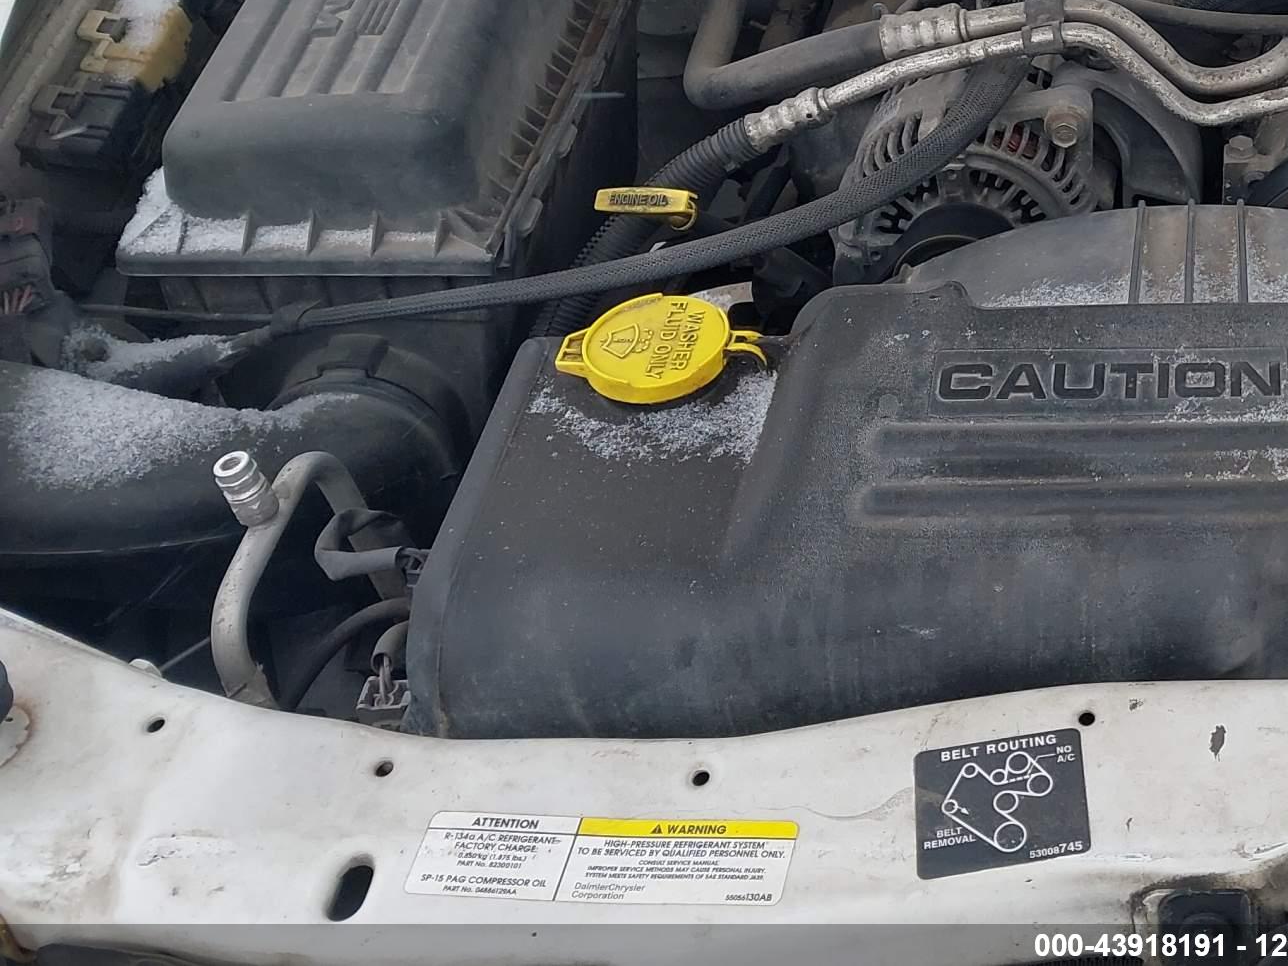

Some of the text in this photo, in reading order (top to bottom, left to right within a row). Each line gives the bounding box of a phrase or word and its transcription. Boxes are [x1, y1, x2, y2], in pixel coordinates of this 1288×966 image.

[608, 194, 668, 206] ENGINE OIL
[646, 301, 688, 379] FLUID ONLY
[669, 310, 706, 371] WASHER
[937, 361, 1282, 400] CAUTION
[941, 734, 1057, 762] BELT ROUTING
[1056, 746, 1072, 754] NO
[1057, 754, 1076, 763] A/C
[472, 817, 539, 829] ATTENTION
[667, 825, 727, 834] WARNING
[936, 827, 962, 839] BELT
[444, 832, 475, 840] R-134a
[476, 834, 496, 842] A/C
[924, 835, 976, 850] REMOVAL
[454, 842, 496, 850] FACTORY
[604, 840, 765, 849] HIGH-PRESSURE REFRIGERANT SYSTEM
[1029, 841, 1083, 859] 53008745
[578, 847, 785, 859] TO BE SERVICED BY QUALIFIED PERSONNEL ONLY.
[420, 874, 546, 887] SP-15 PAG COMPRESSOR OIL
[575, 882, 645, 892] DaimlerChrysler
[572, 891, 624, 900] Corporation
